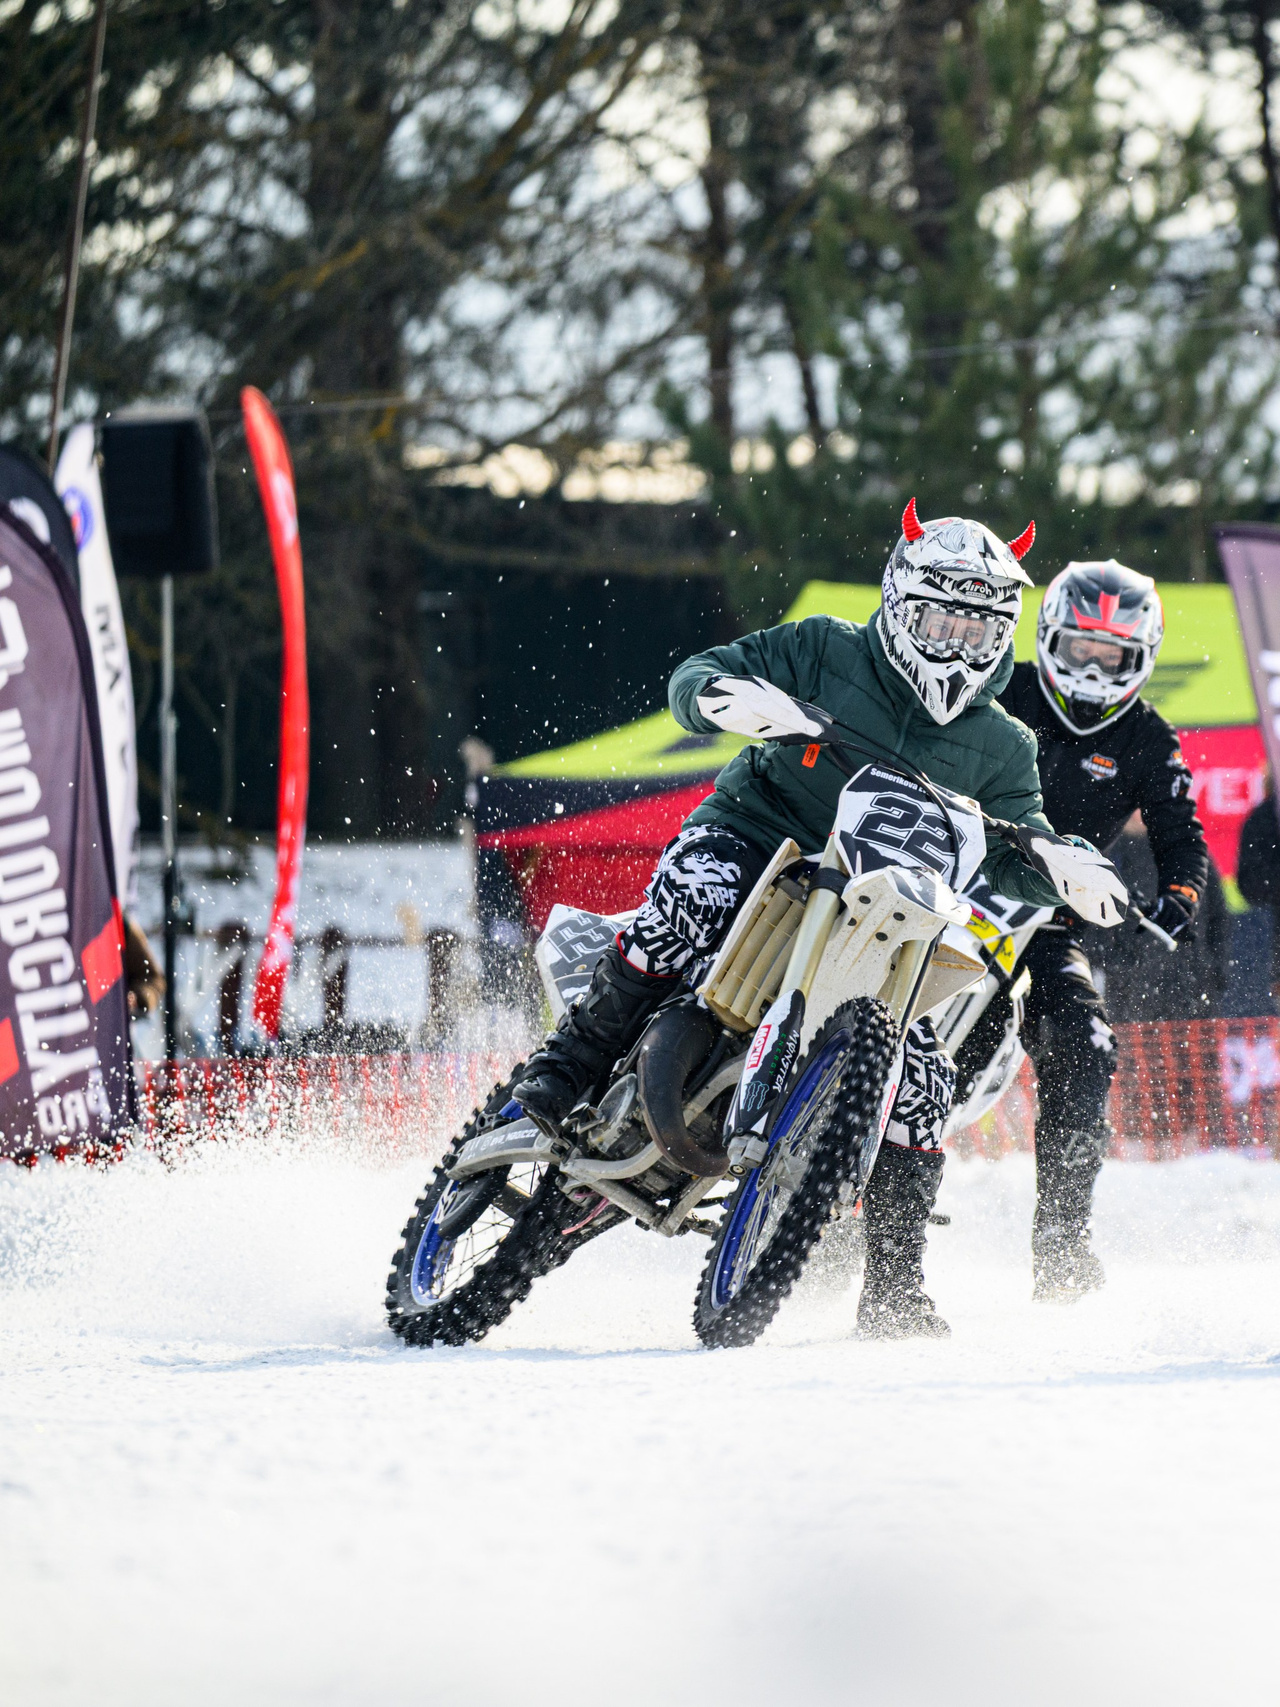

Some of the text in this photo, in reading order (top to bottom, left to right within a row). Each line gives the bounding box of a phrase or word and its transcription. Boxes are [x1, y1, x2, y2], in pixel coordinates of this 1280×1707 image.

[958, 579, 993, 596] Airoh
[870, 767, 918, 791] Semerikova
[852, 793, 968, 876] 22
[747, 1025, 770, 1069] MOTUL
[768, 1033, 787, 1075] ENERGY
[773, 1030, 800, 1093] MONSTER
